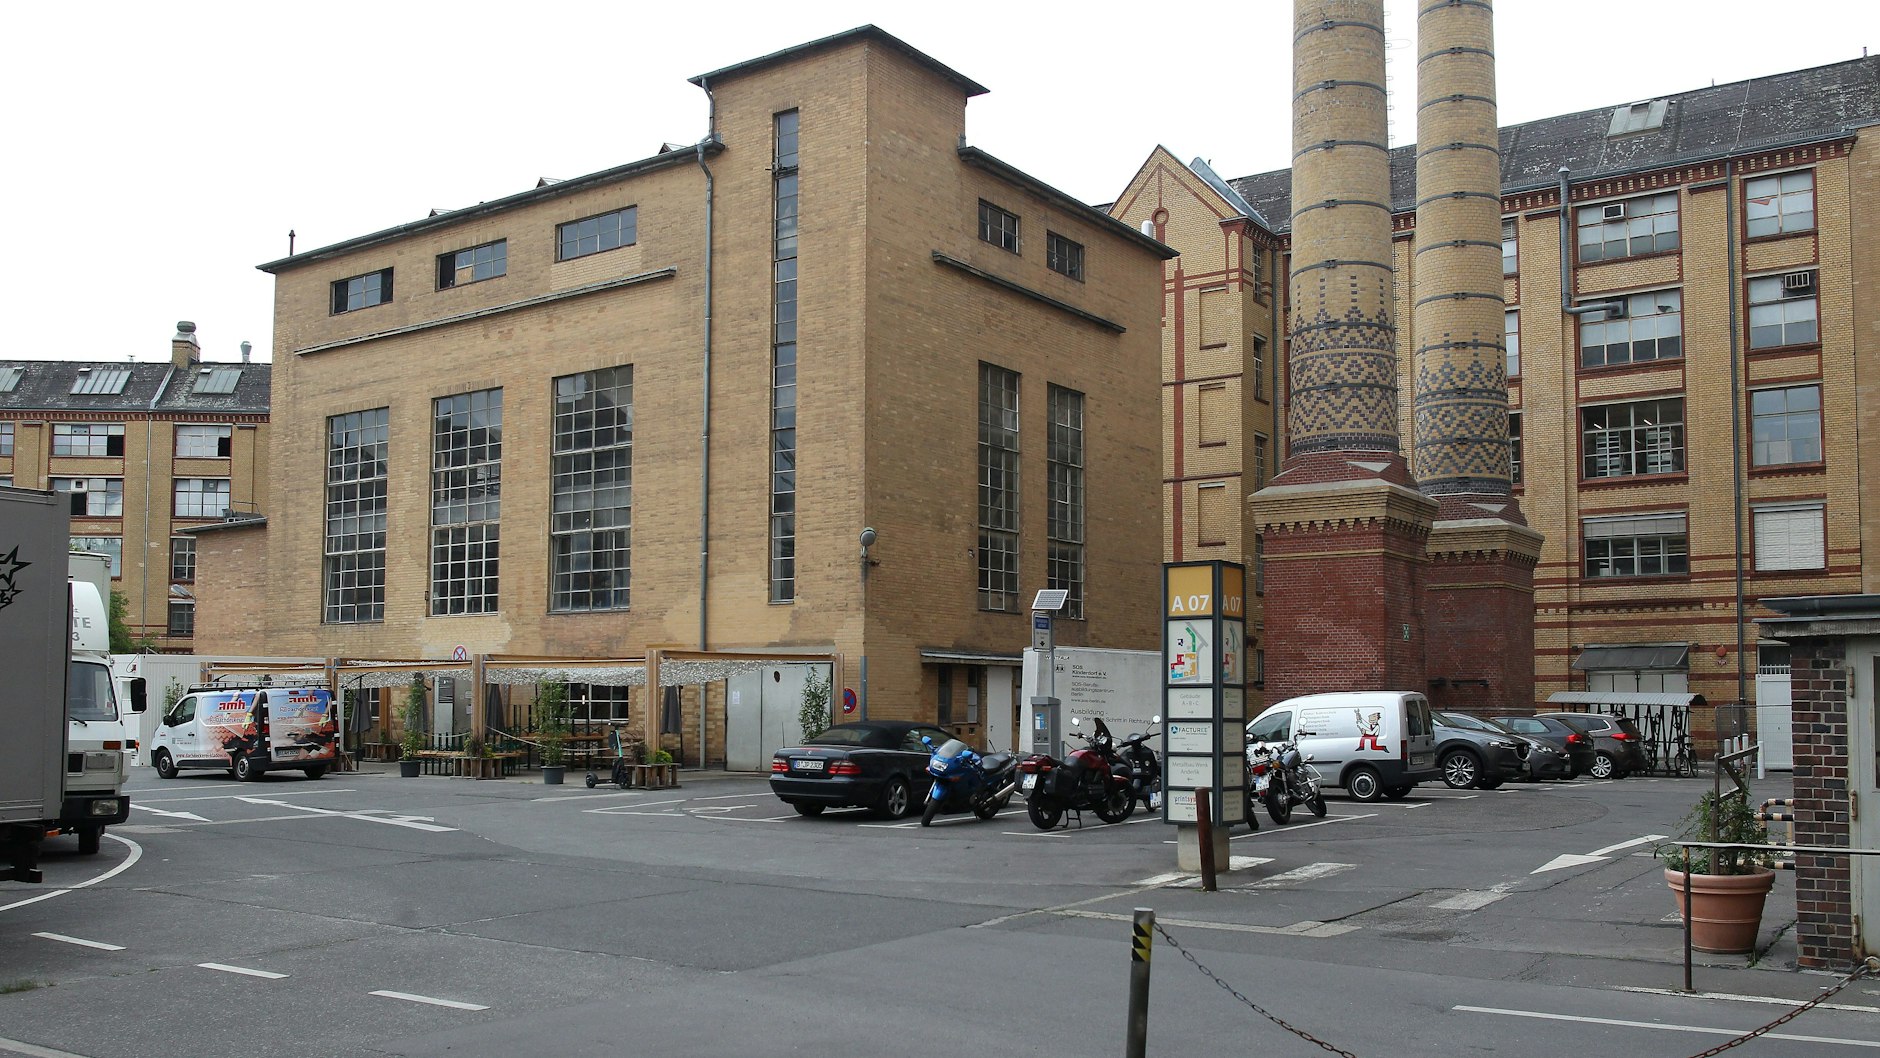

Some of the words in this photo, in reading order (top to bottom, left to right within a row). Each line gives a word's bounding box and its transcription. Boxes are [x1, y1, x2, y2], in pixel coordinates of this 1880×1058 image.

[1171, 595, 1184, 612] A
[1188, 594, 1209, 611] 07
[1222, 595, 1229, 611] A
[1230, 596, 1240, 613] 07
[219, 699, 246, 711] amh
[1070, 708, 1104, 716] Ausbildung
